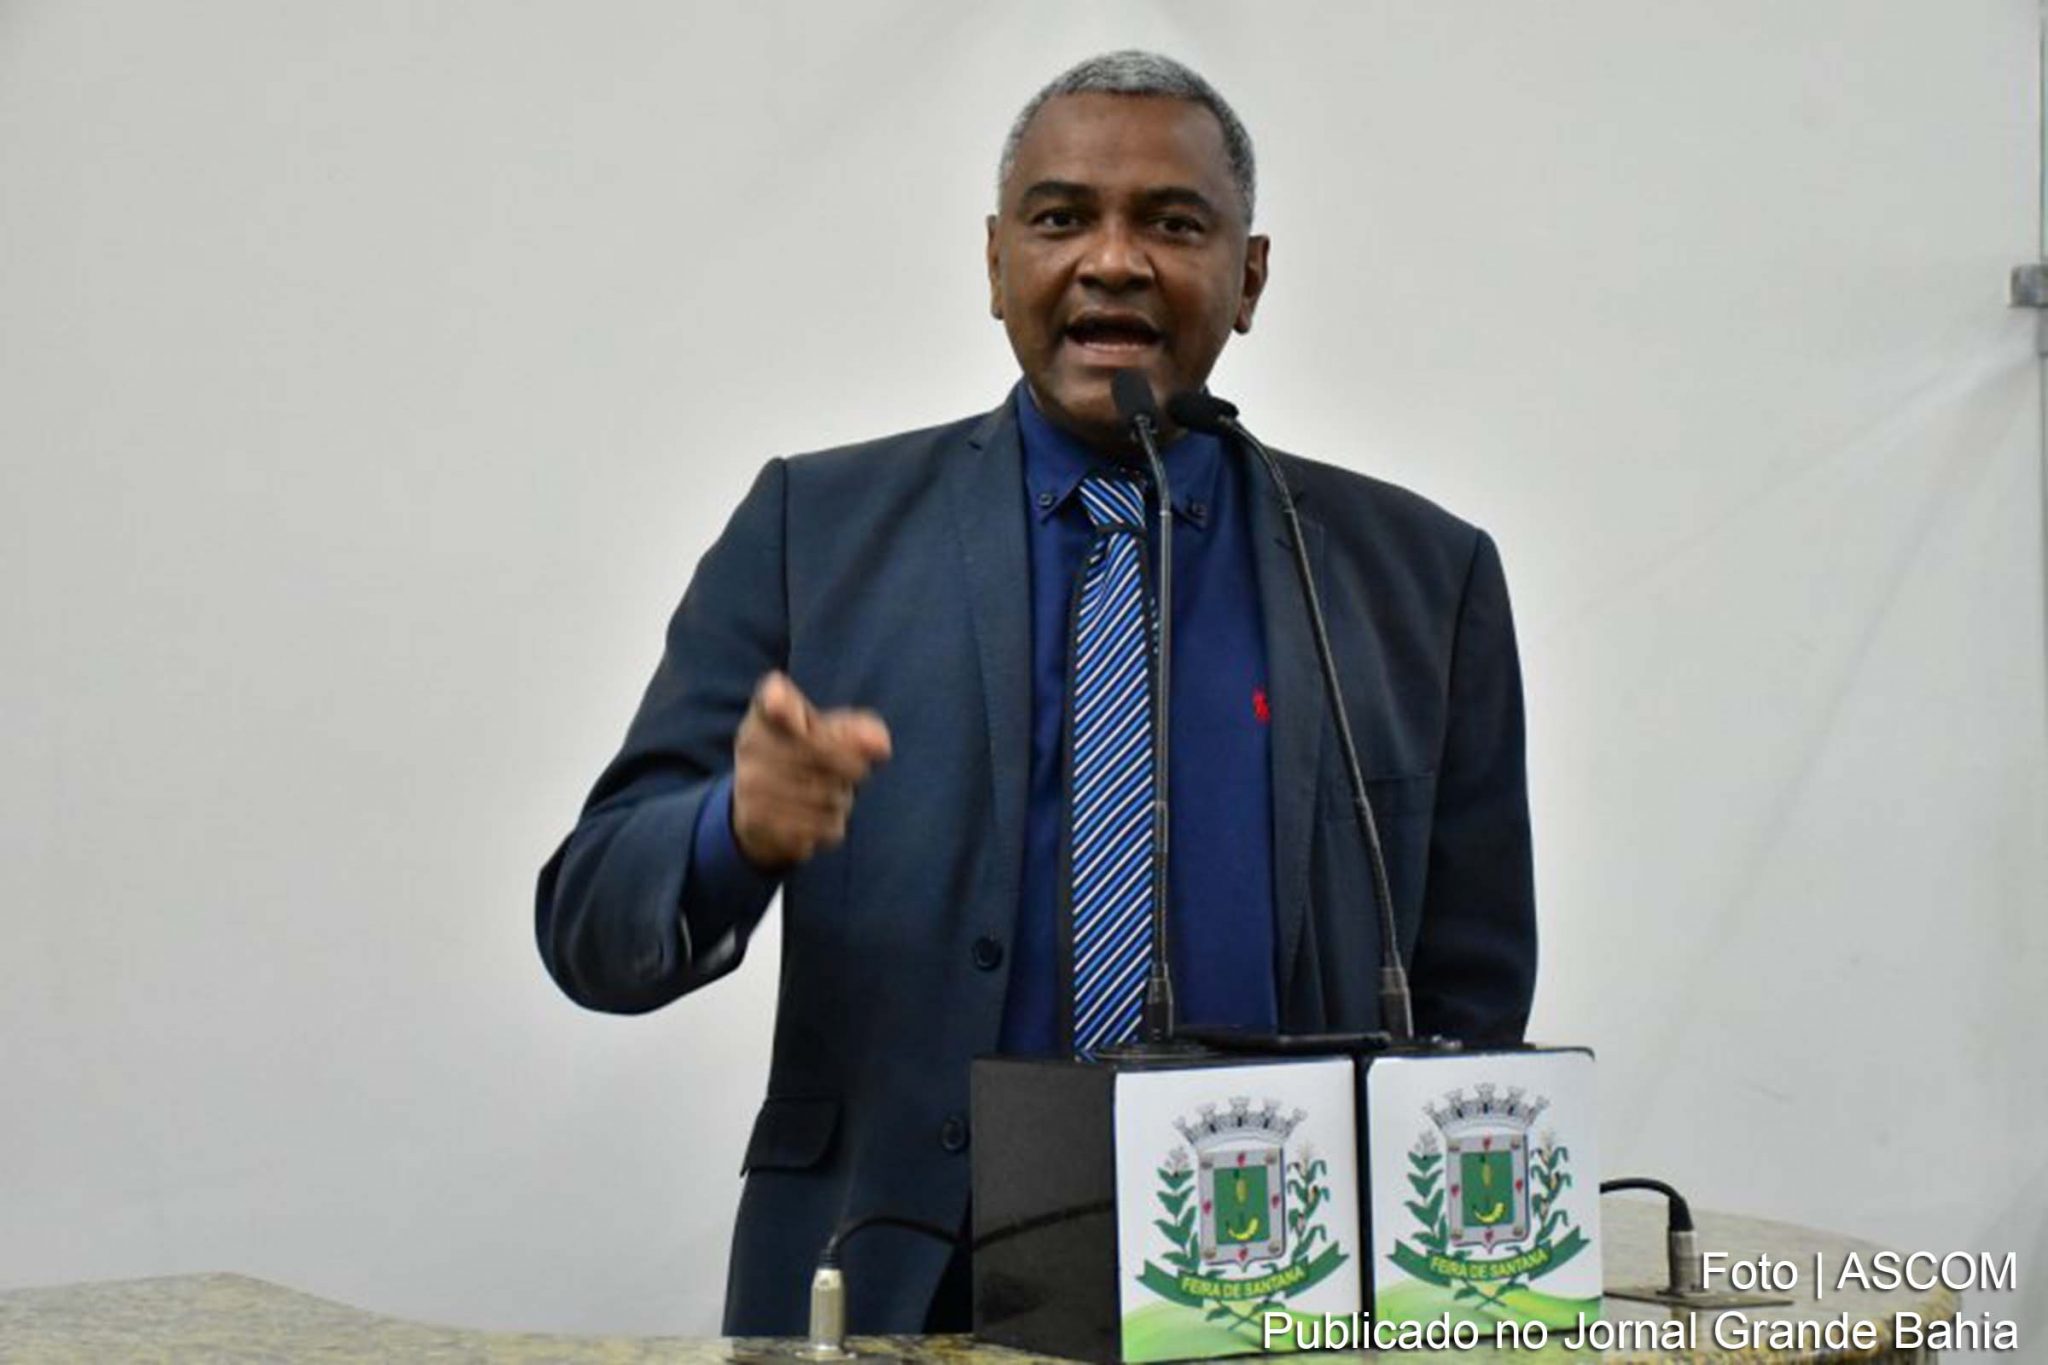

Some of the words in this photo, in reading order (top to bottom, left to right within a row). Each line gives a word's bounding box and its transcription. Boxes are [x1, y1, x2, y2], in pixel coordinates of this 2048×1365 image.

[1431, 1255, 1469, 1276] FEIRA
[1471, 1263, 1488, 1276] DE
[1489, 1248, 1549, 1276] SANTANA
[1181, 1276, 1220, 1296] FEIRA
[1222, 1282, 1239, 1296] DE
[1244, 1265, 1305, 1296] SANTANA
